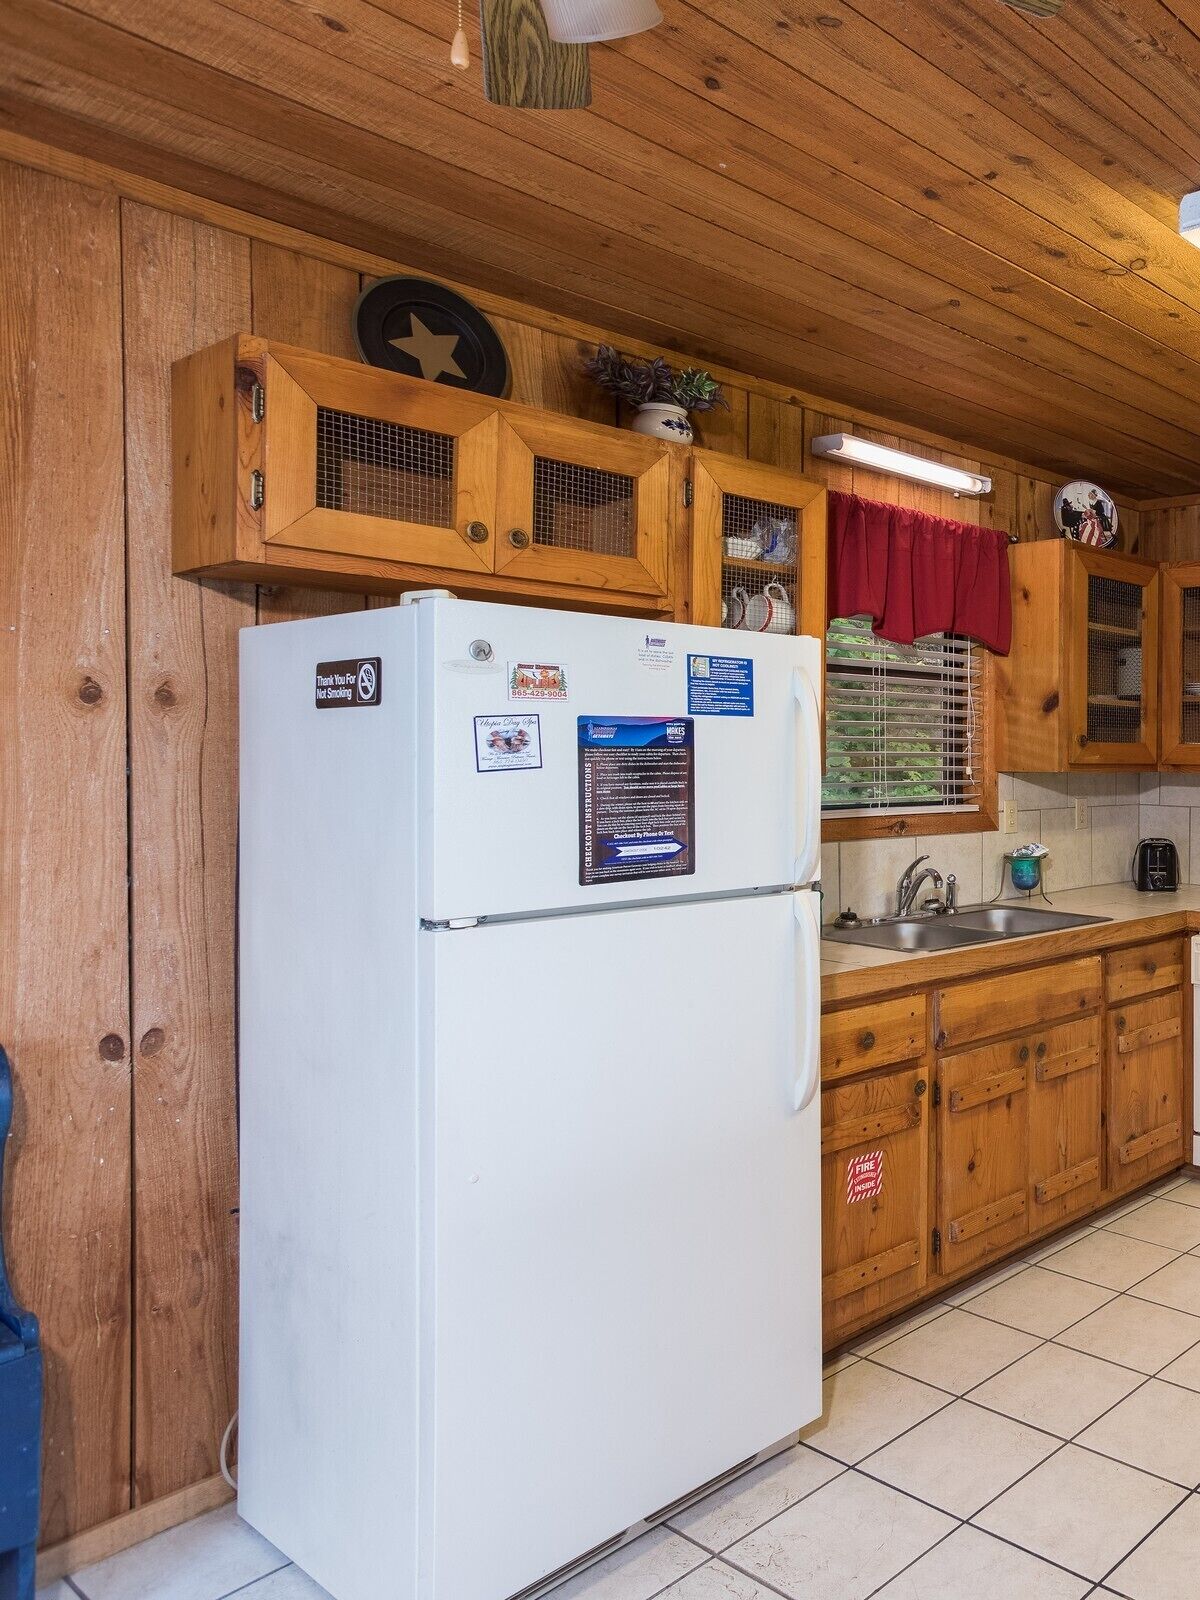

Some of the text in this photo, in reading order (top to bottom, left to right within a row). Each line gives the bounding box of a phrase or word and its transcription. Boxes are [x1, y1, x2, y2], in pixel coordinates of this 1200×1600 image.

[317, 673, 356, 686] Thank You For
[317, 687, 352, 700] Not Smoking
[503, 718, 520, 728] Day
[522, 717, 536, 727] Spa
[856, 1160, 875, 1174] FIRE
[855, 1180, 875, 1192] INSIDE
